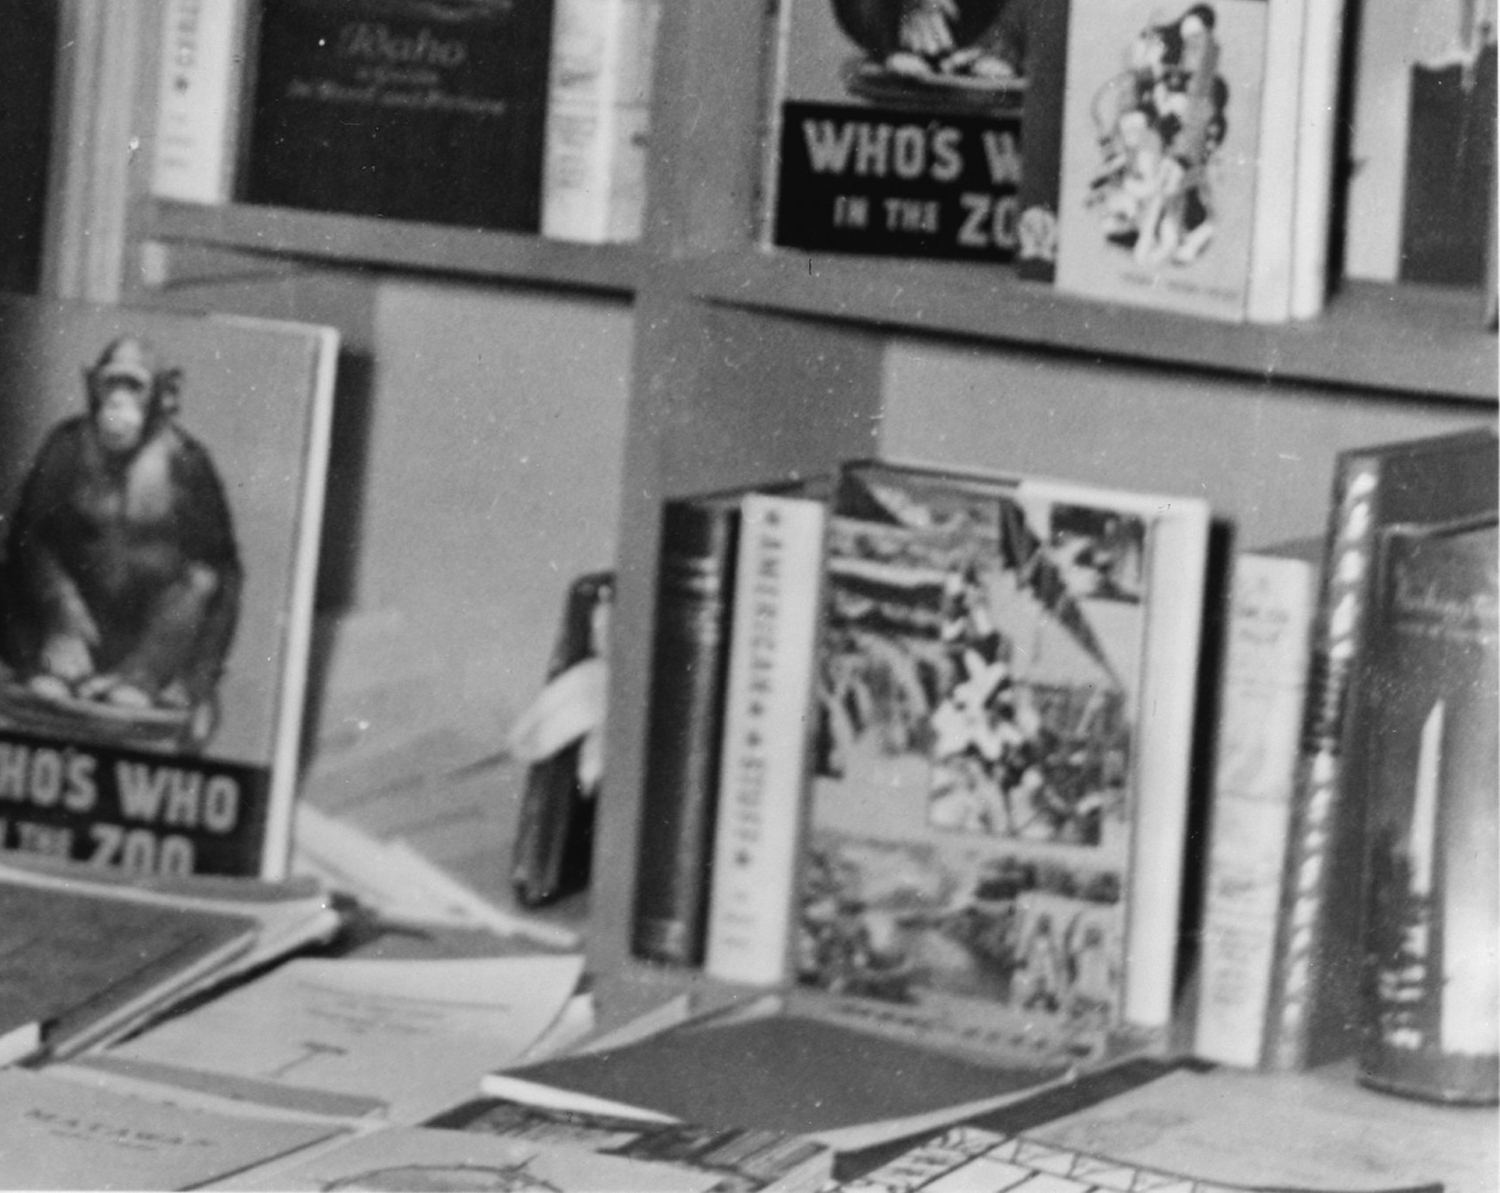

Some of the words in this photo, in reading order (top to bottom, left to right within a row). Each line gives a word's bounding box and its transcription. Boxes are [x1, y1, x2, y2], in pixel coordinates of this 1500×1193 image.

[803, 118, 964, 184] WHO'S
[833, 194, 870, 230] IN
[115, 760, 241, 835] WHO
[89, 822, 195, 875] ZOO
